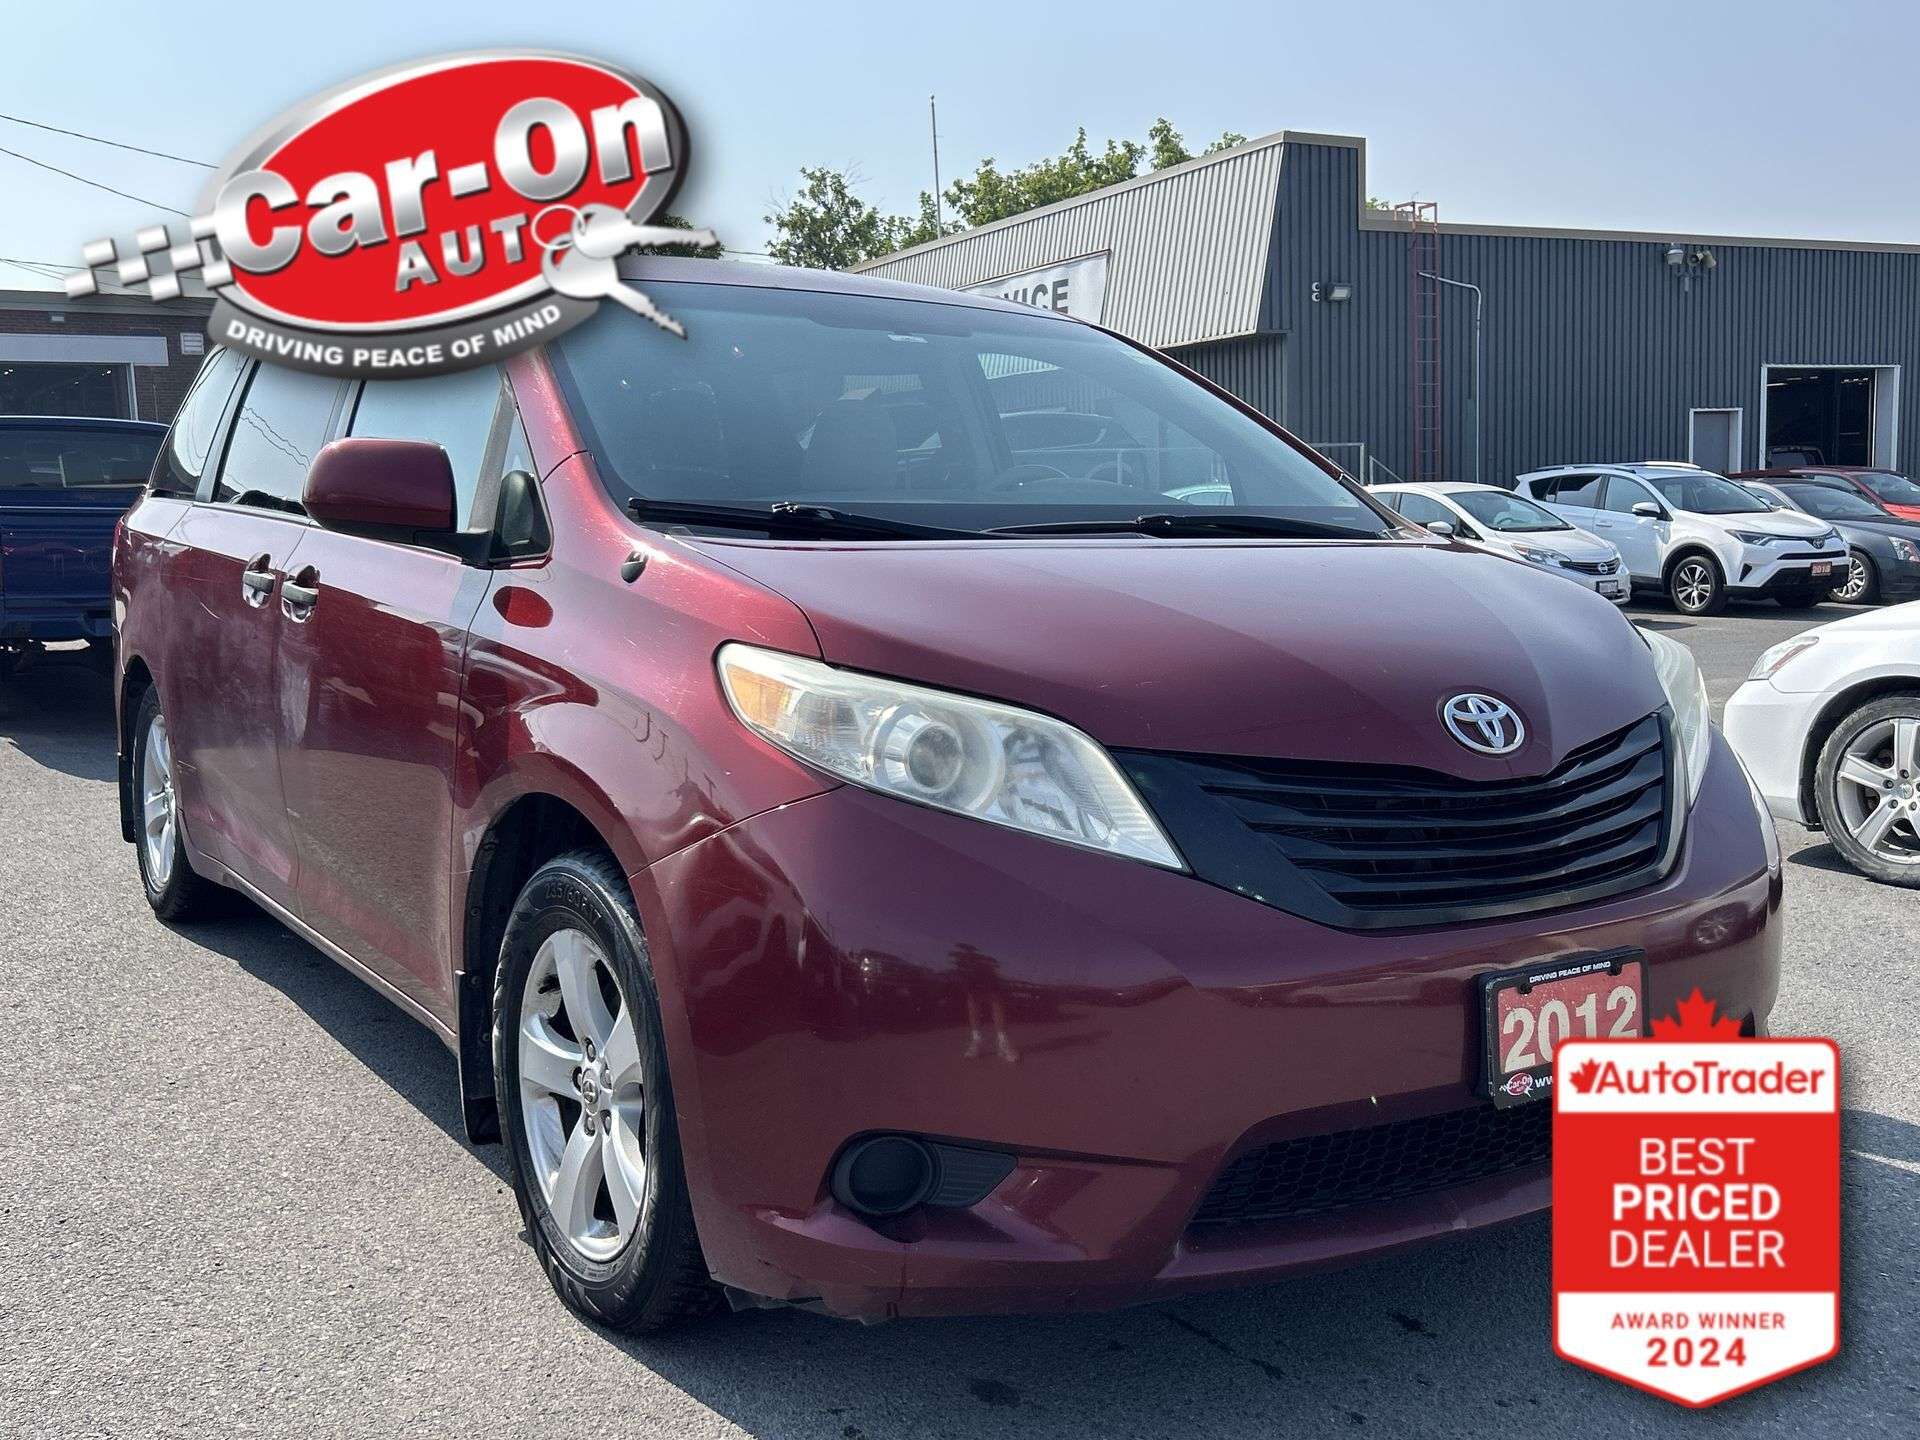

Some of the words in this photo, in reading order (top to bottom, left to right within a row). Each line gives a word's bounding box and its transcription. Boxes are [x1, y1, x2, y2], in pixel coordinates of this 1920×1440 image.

[1529, 971, 1558, 984] DRIVING
[1558, 967, 1581, 978] PEACE
[1582, 964, 1592, 973] OF
[1592, 961, 1611, 971] MIND
[1503, 985, 1638, 1073] 2012
